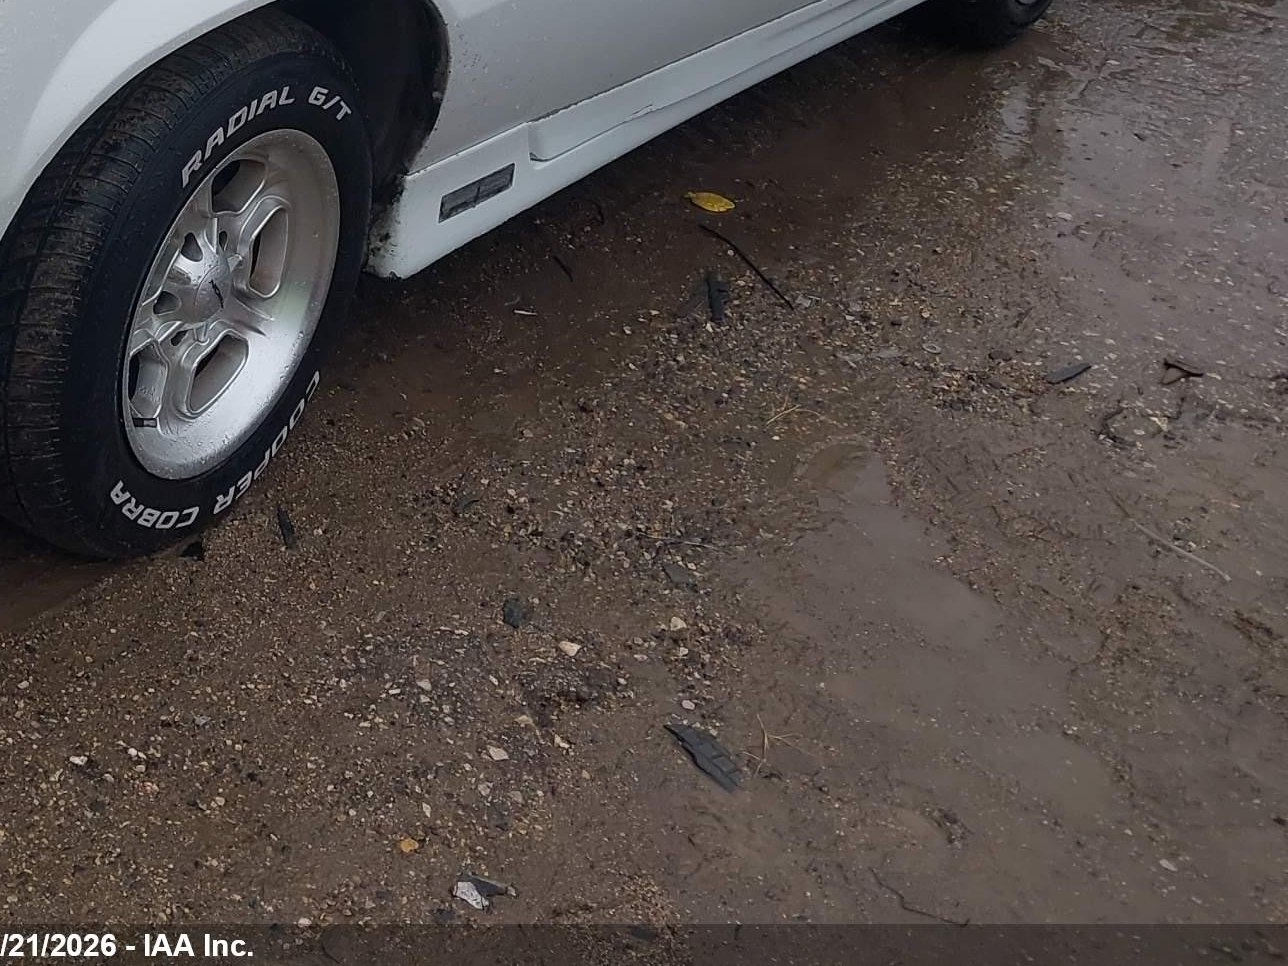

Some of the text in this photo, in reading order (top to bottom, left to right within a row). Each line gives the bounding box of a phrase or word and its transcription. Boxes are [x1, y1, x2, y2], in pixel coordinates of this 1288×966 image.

[182, 86, 352, 188] RADIAL G/T
[110, 370, 320, 529] COOPER COBRA
